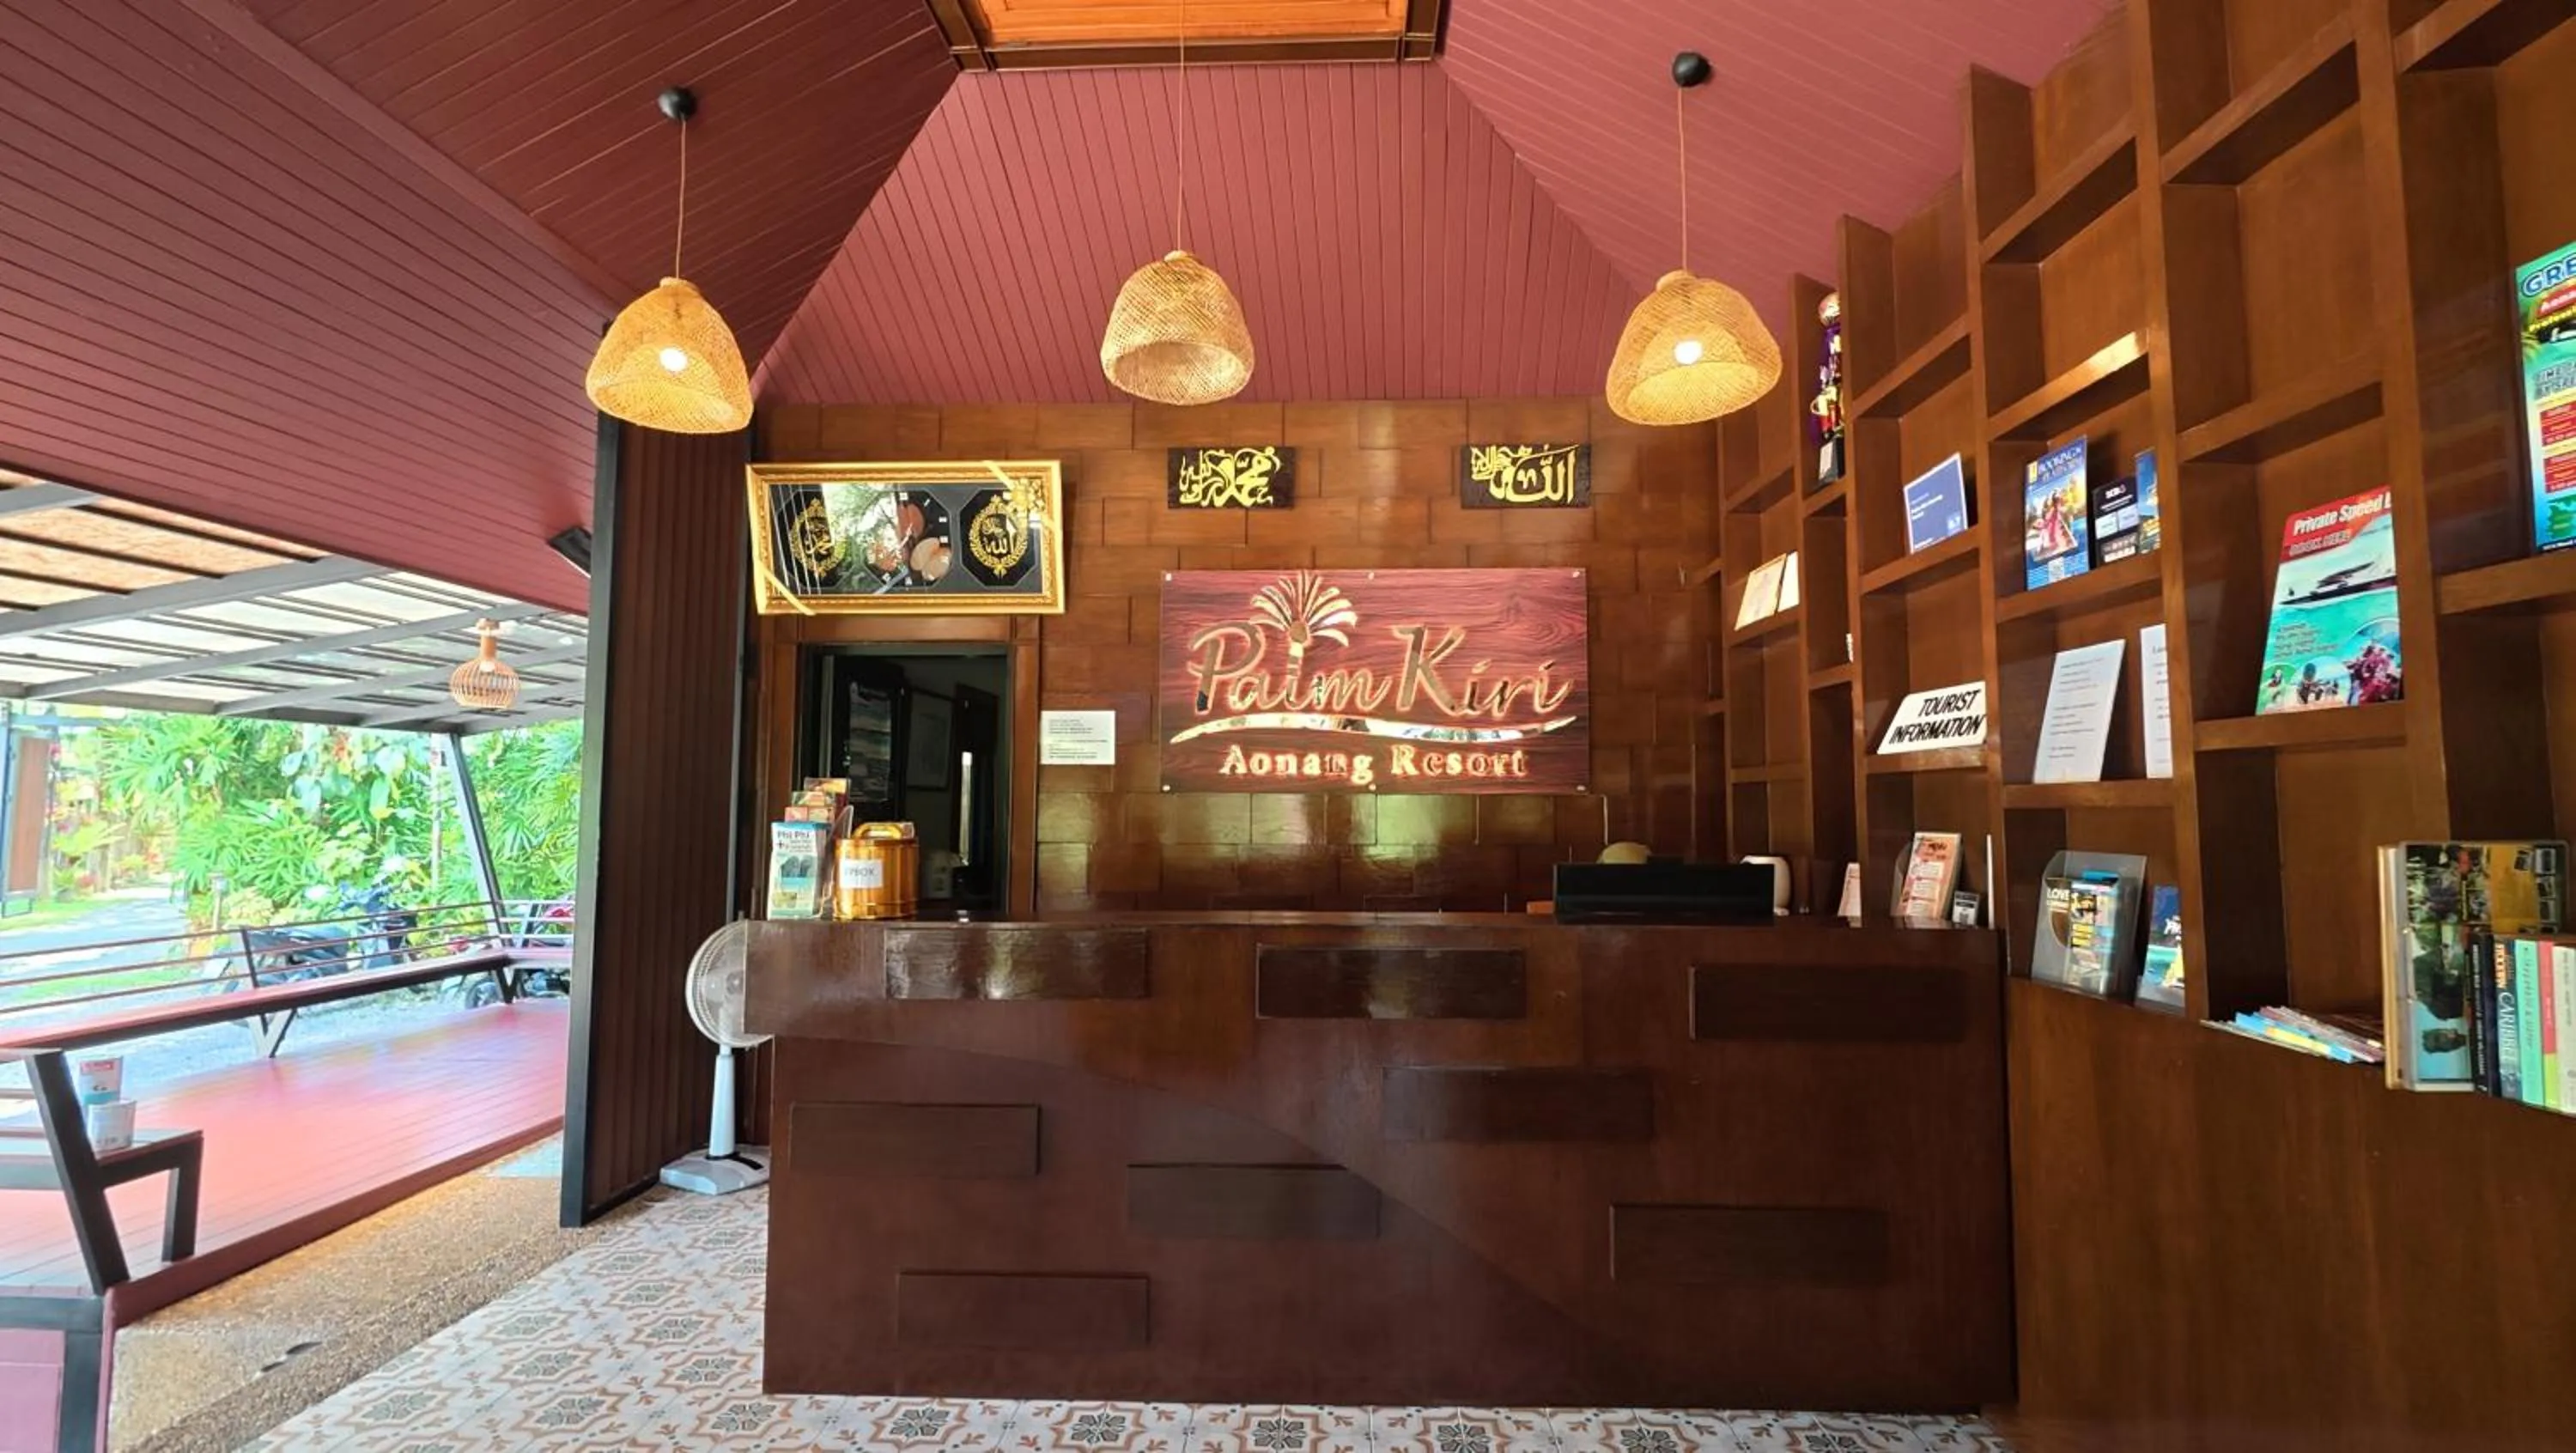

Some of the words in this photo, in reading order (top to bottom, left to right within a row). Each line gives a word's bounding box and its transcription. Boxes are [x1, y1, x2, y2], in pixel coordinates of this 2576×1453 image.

[2293, 509, 2338, 536] Private
[2339, 493, 2384, 522] Speed
[1388, 623, 1577, 717] Kiri
[1917, 688, 1981, 717] TOURIST
[1889, 714, 1987, 745] INFORMATION
[1218, 744, 1376, 786] Aonang
[1389, 745, 1528, 777] Resort
